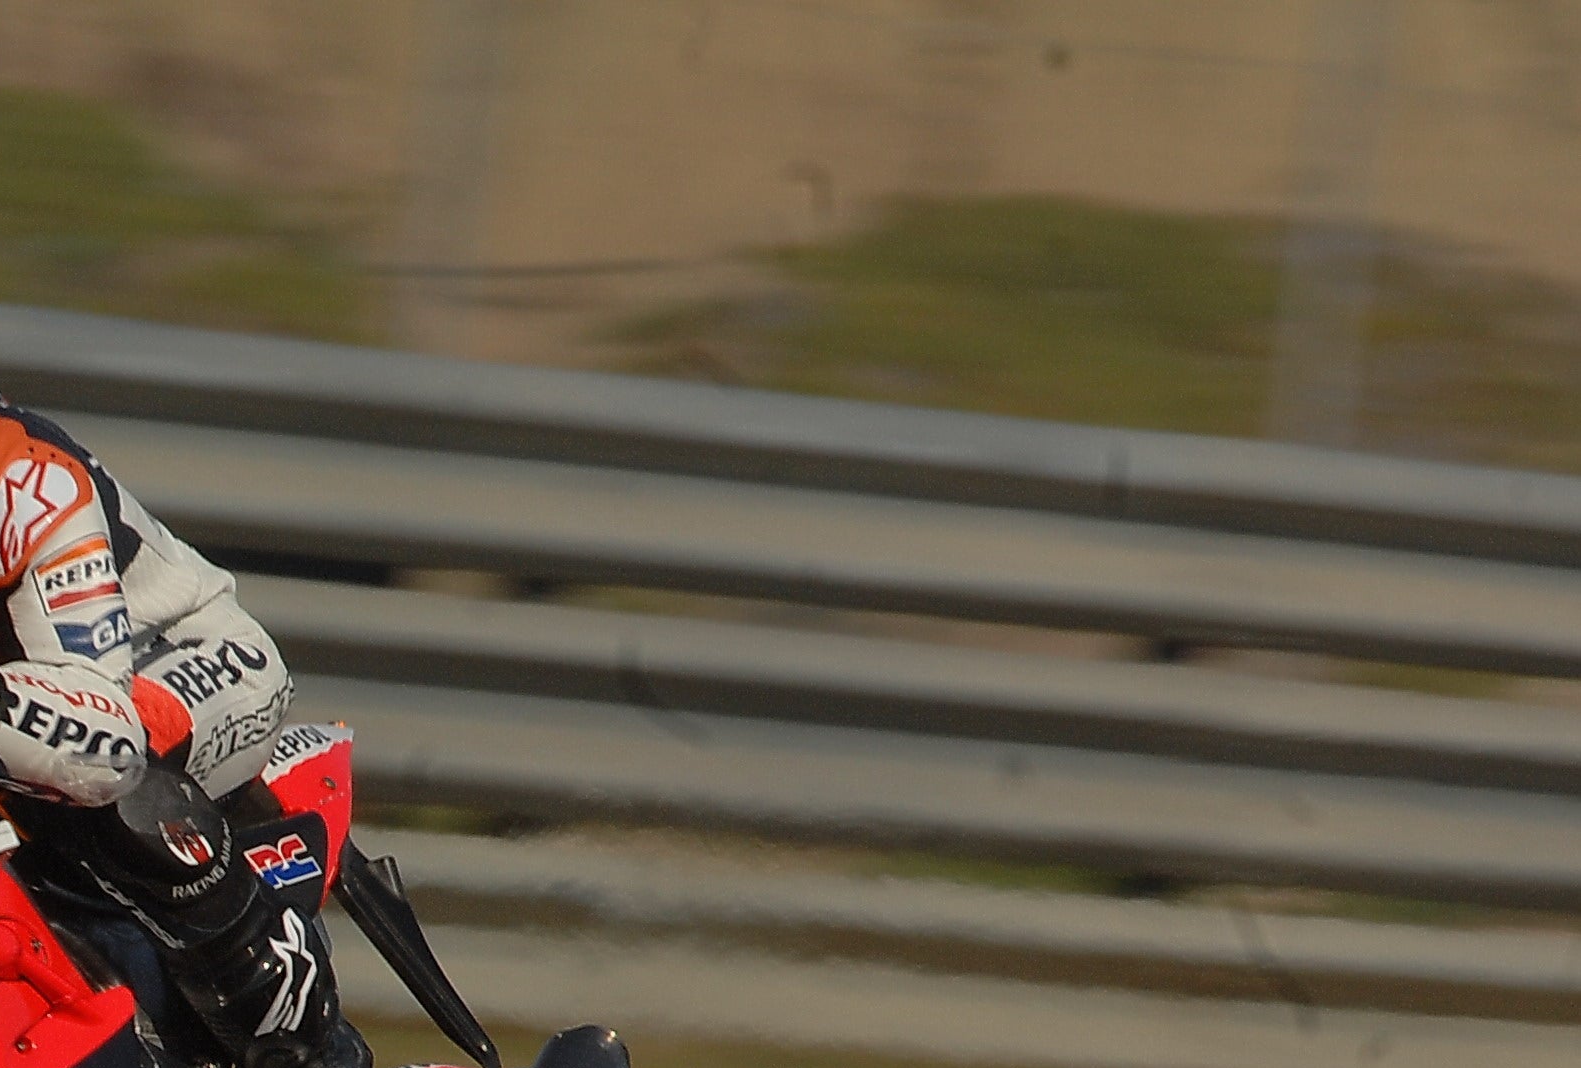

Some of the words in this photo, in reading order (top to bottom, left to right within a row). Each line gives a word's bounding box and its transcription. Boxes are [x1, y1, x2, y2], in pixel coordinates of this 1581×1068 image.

[91, 612, 132, 650] GA
[5, 671, 134, 727] HONDA
[162, 639, 268, 709] REPSO
[1, 688, 140, 774] REPSO
